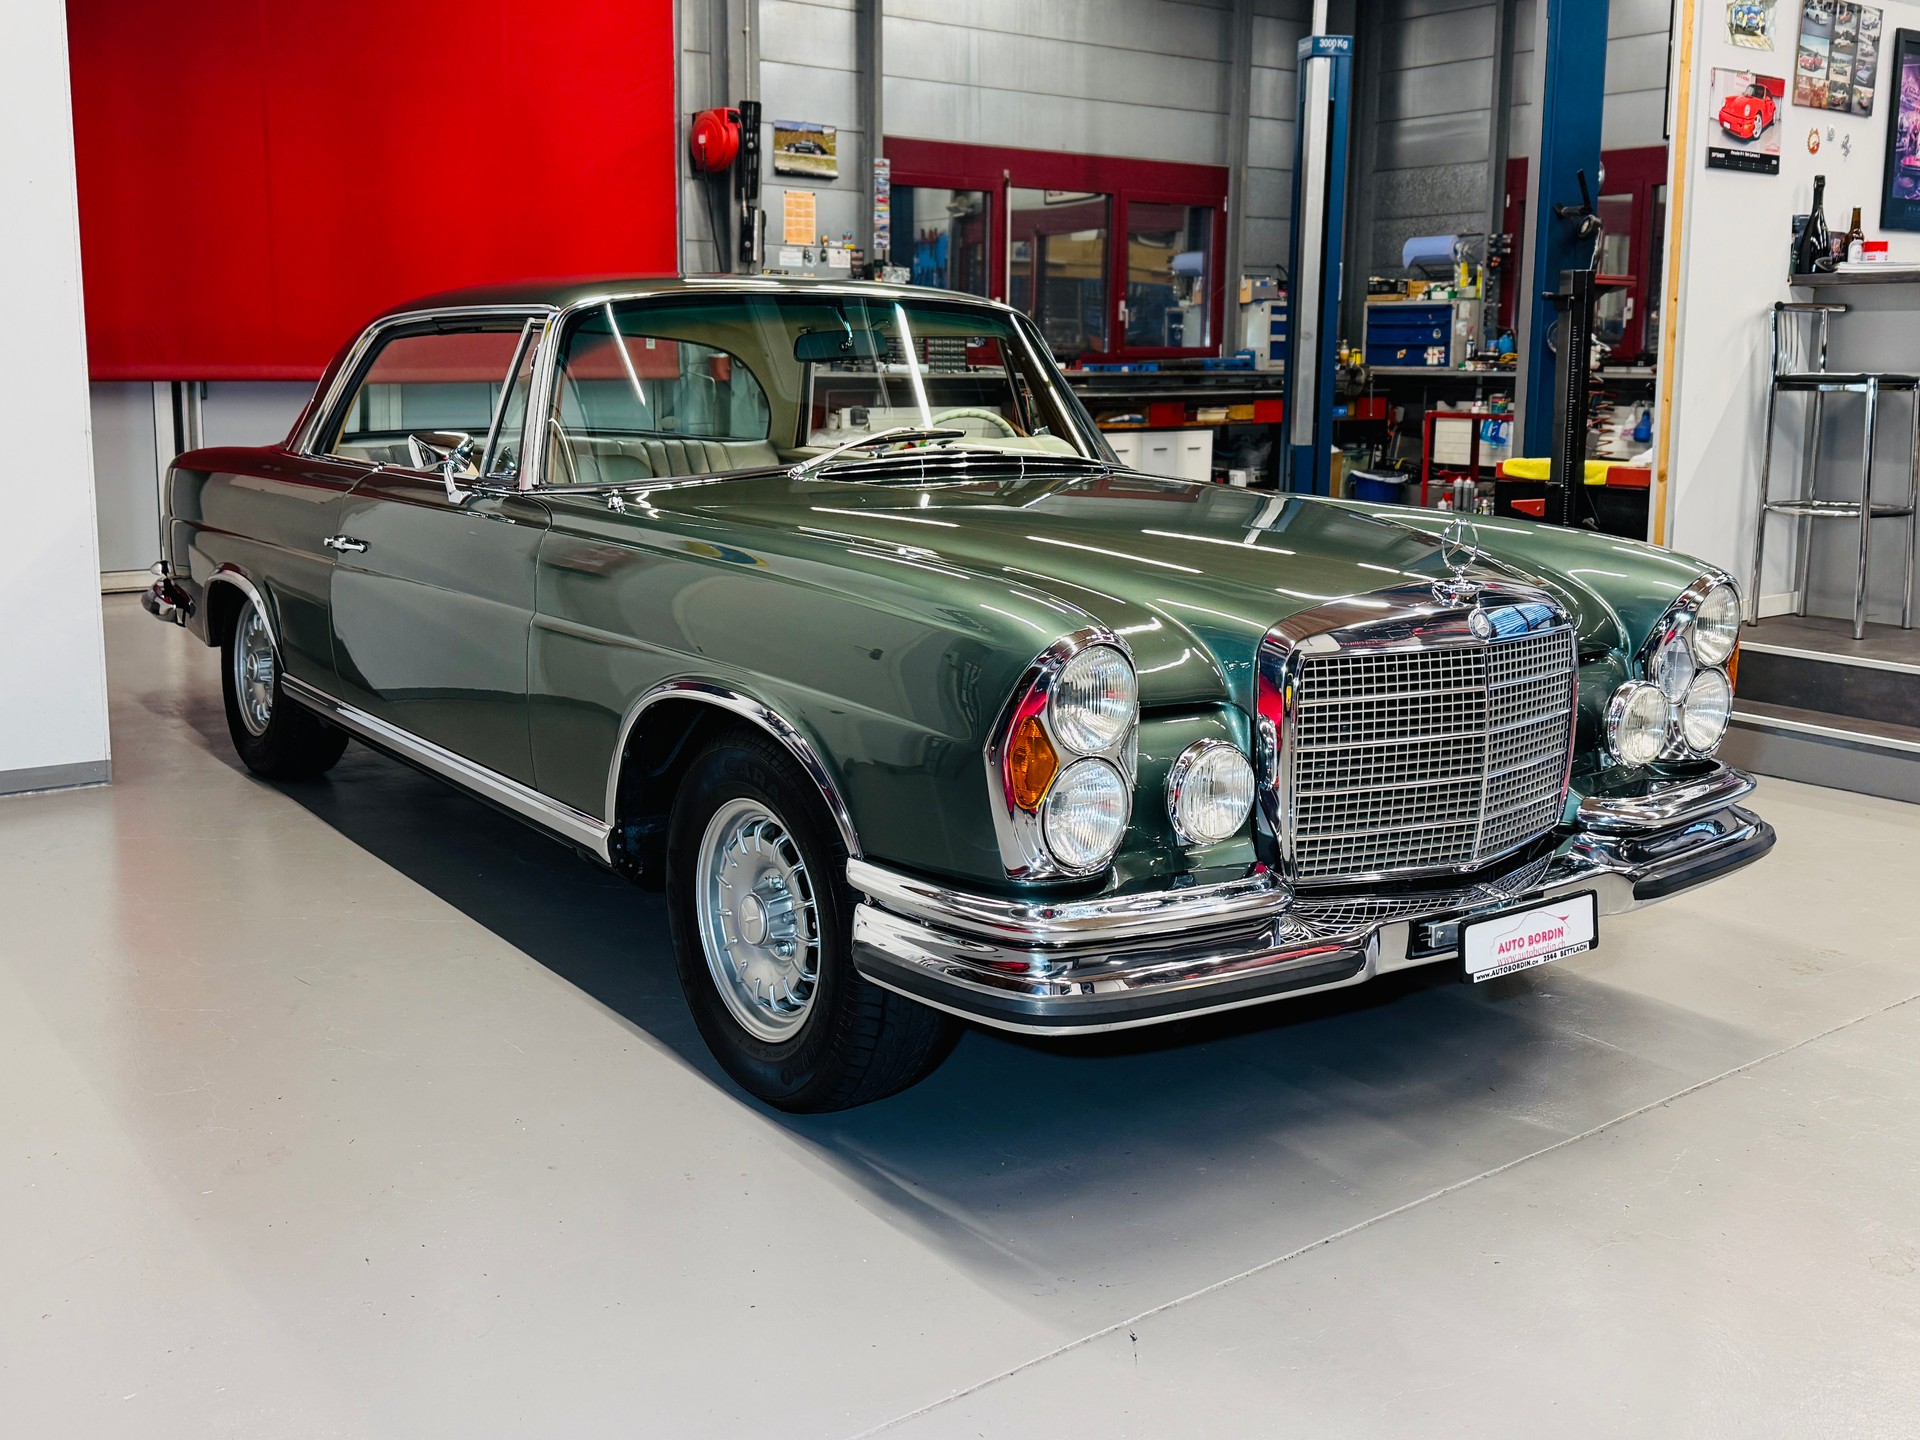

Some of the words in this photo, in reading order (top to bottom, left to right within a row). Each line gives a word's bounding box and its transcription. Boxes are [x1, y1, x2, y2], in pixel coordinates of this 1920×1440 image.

[1319, 38, 1336, 48] 3000
[1337, 38, 1348, 49] Kg
[1497, 937, 1525, 954] AUTO
[1528, 927, 1564, 947] BORDIN
[1560, 943, 1588, 958] BETTLACH
